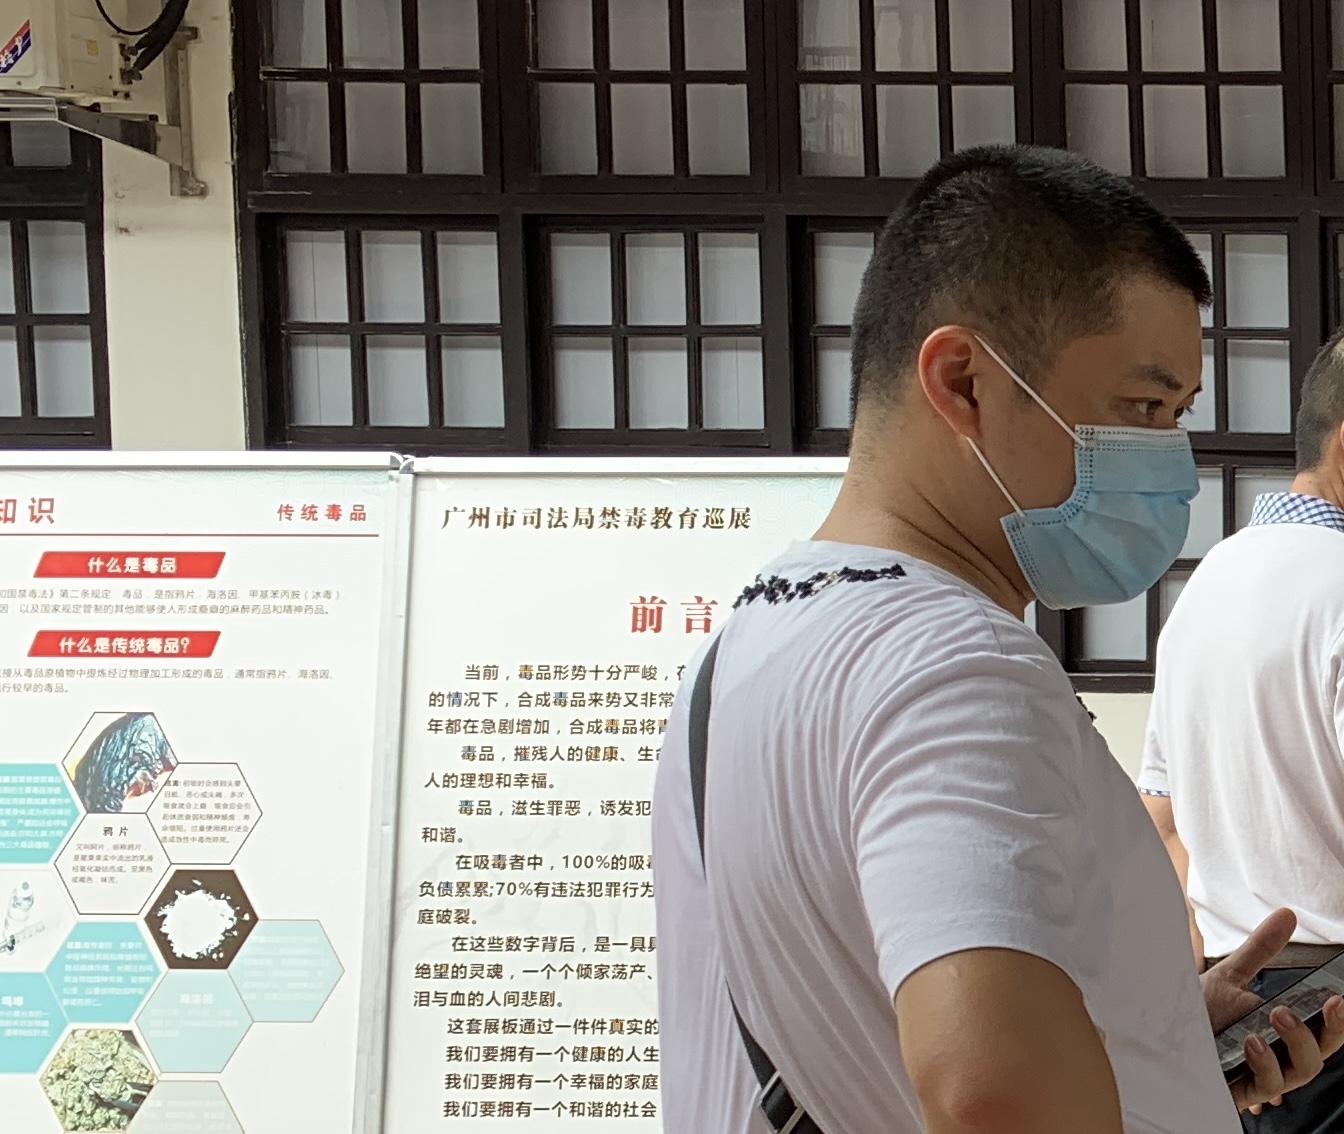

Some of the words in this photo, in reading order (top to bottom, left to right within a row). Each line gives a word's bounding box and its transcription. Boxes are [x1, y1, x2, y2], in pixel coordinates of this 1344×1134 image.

[277, 503, 367, 522] 传统毒品
[441, 506, 752, 530] 广州市司法局禁毒教育巡展
[88, 557, 177, 574] 什么是毒品
[630, 596, 718, 633] 前言
[428, 692, 675, 708] 的情况下，合成毒品来势又非常
[424, 772, 555, 789] 人的理想和幸福。
[458, 799, 652, 817] 毒品，滋生罪恶，诱发犯
[422, 826, 464, 843] 和谐。
[417, 908, 478, 925] 庭破裂。
[414, 963, 655, 981] 绝望的灵魂，一个个倾家荡产、
[413, 991, 563, 1008] 泪与血的人间悲剧。
[447, 1018, 659, 1036] 这套展板通过一件件真实的
[445, 1046, 659, 1063] 我们要拥有一个健康的人生
[444, 1073, 658, 1090] 我们要拥有一个幸福的家庭
[443, 1101, 657, 1118] 我们要拥有一个和谐的社会
